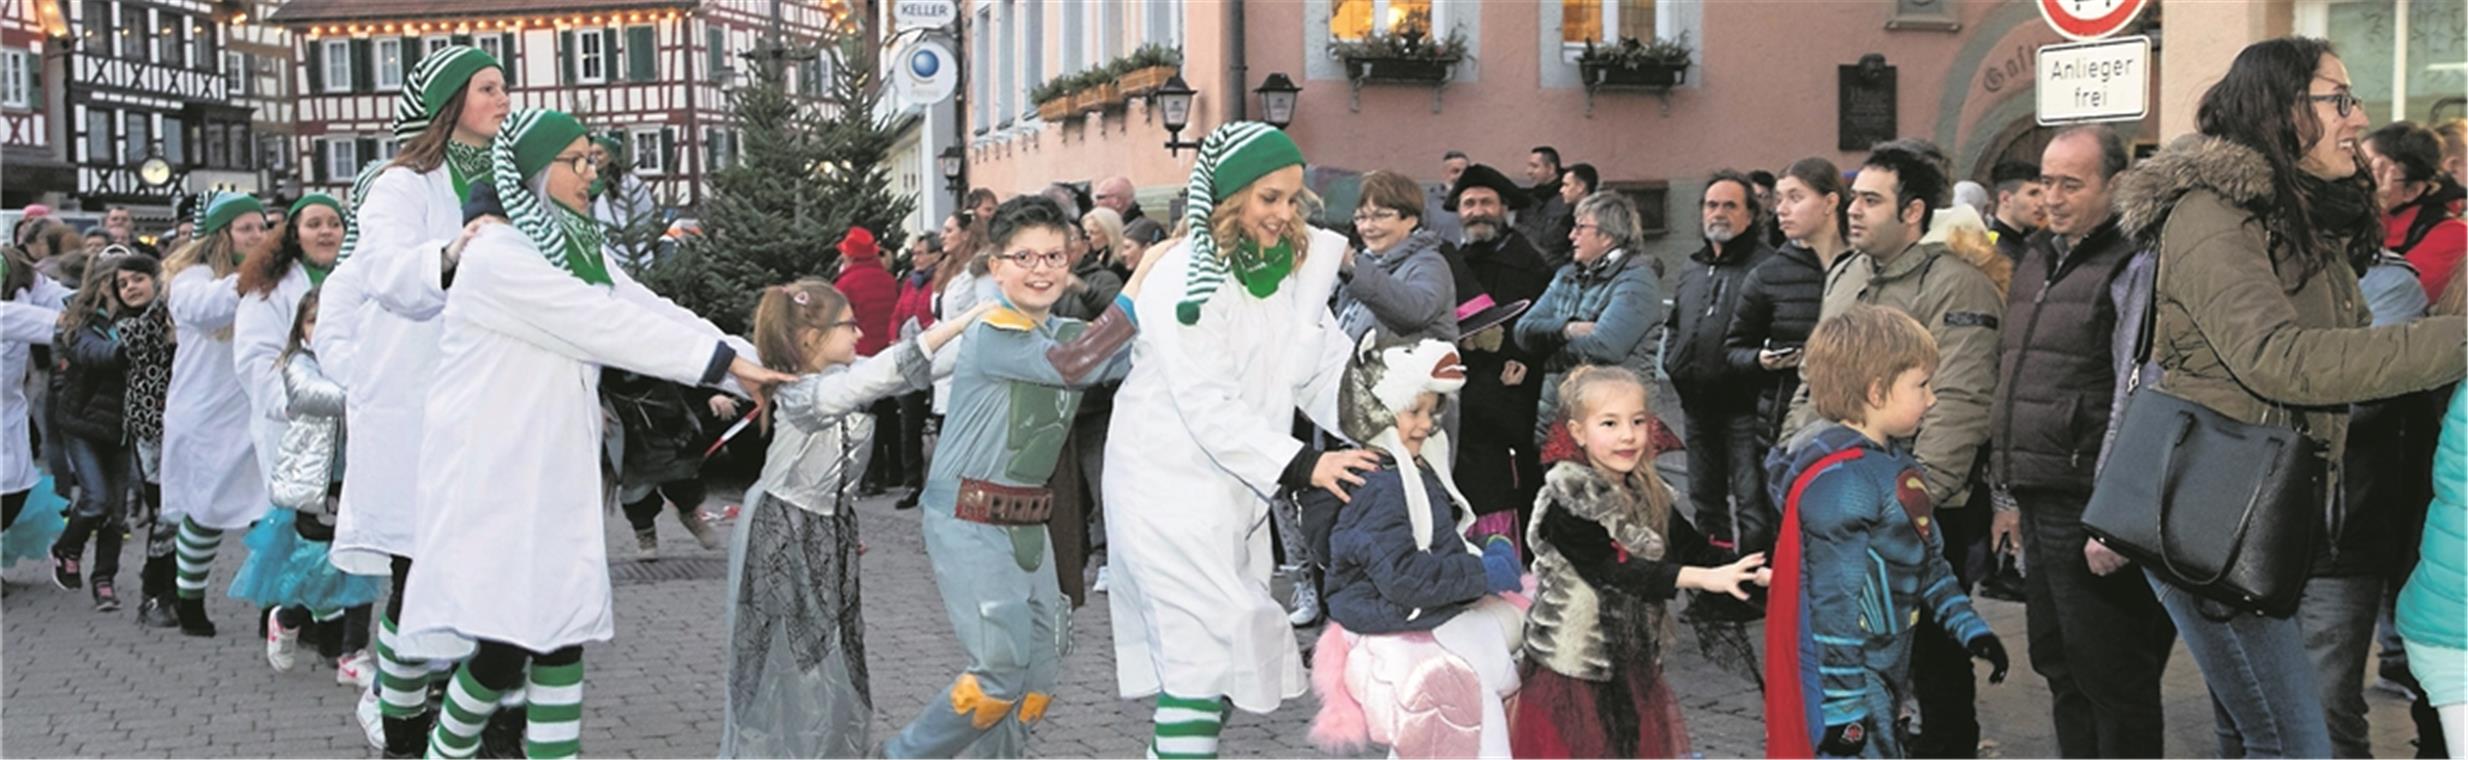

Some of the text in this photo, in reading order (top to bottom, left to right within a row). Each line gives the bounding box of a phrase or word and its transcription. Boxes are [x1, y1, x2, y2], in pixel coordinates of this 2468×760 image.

[902, 4, 948, 17] KELLER
[2051, 58, 2133, 82] Anlieger
[2075, 85, 2108, 108] frei
